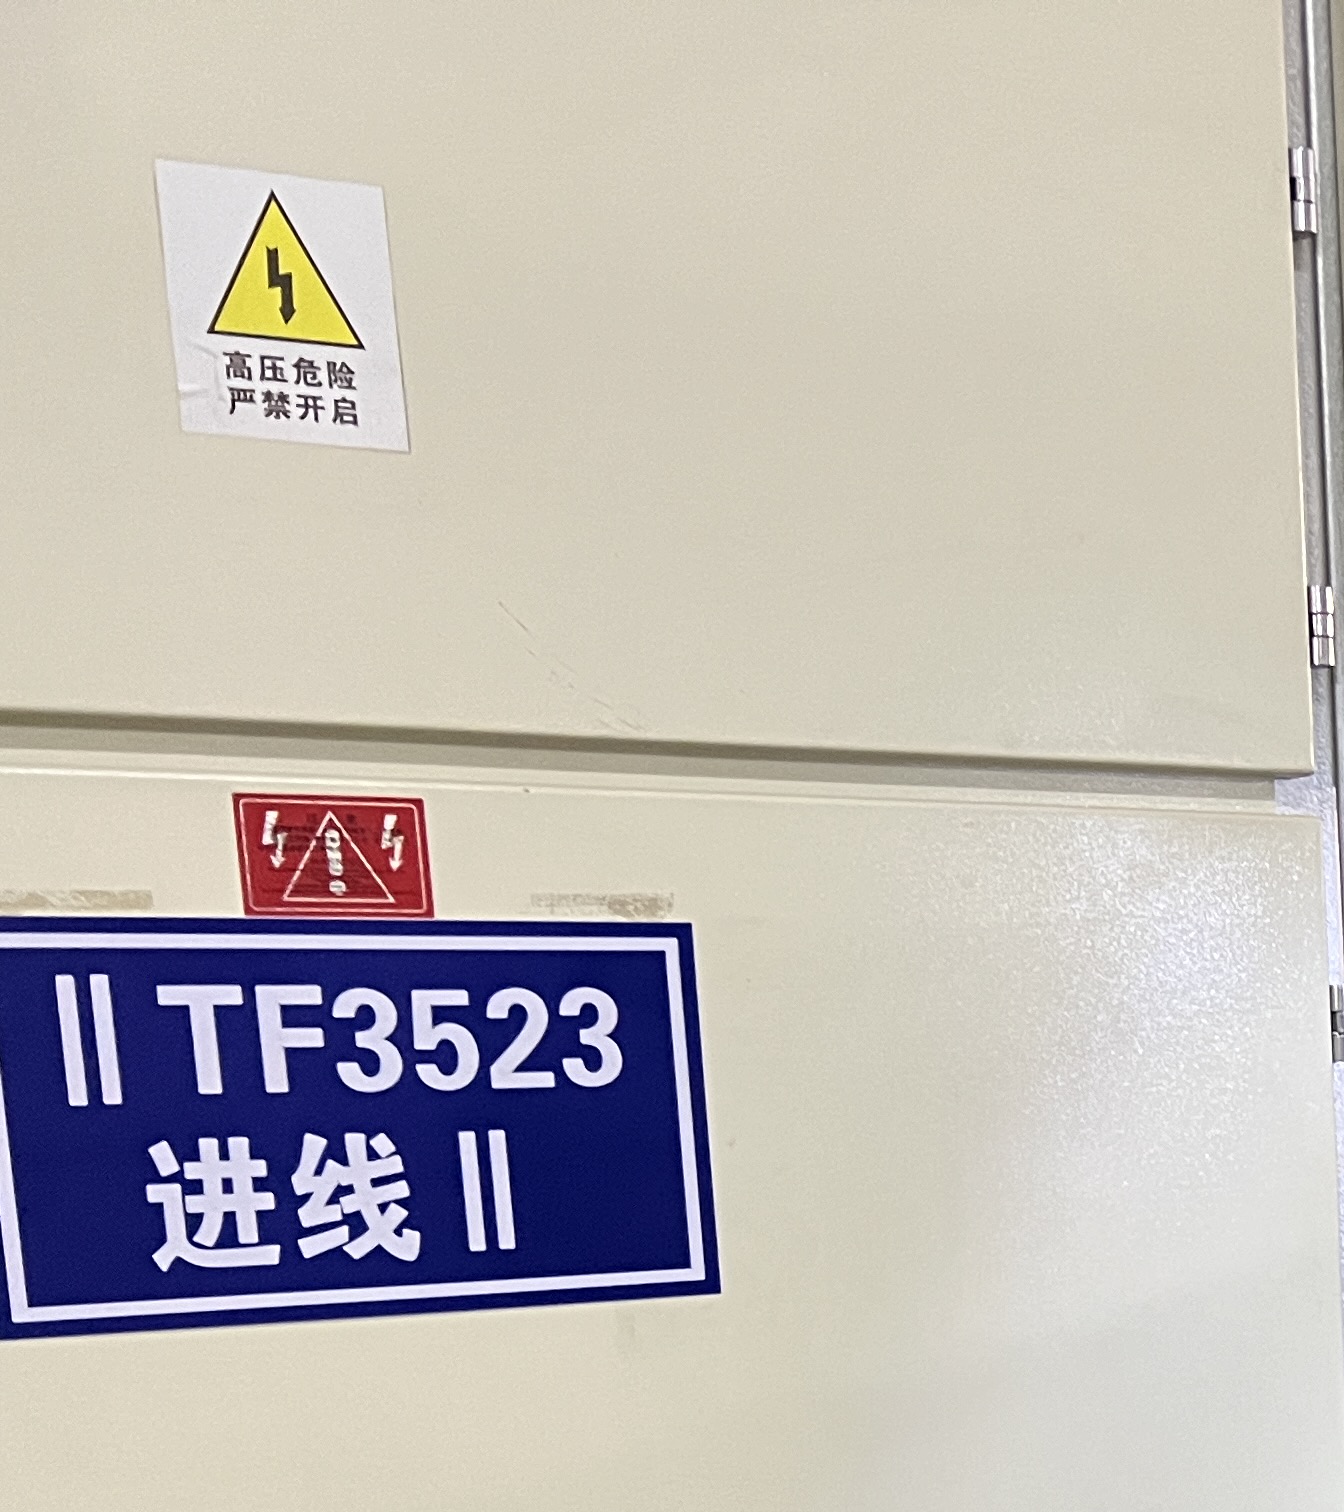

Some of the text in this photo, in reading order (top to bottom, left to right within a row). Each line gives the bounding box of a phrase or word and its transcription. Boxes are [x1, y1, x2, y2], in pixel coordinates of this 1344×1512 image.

[222, 350, 359, 392] 高压危险
[226, 387, 361, 428] 严禁开启
[155, 983, 625, 1096] TF3523
[145, 1130, 421, 1273] 进线
